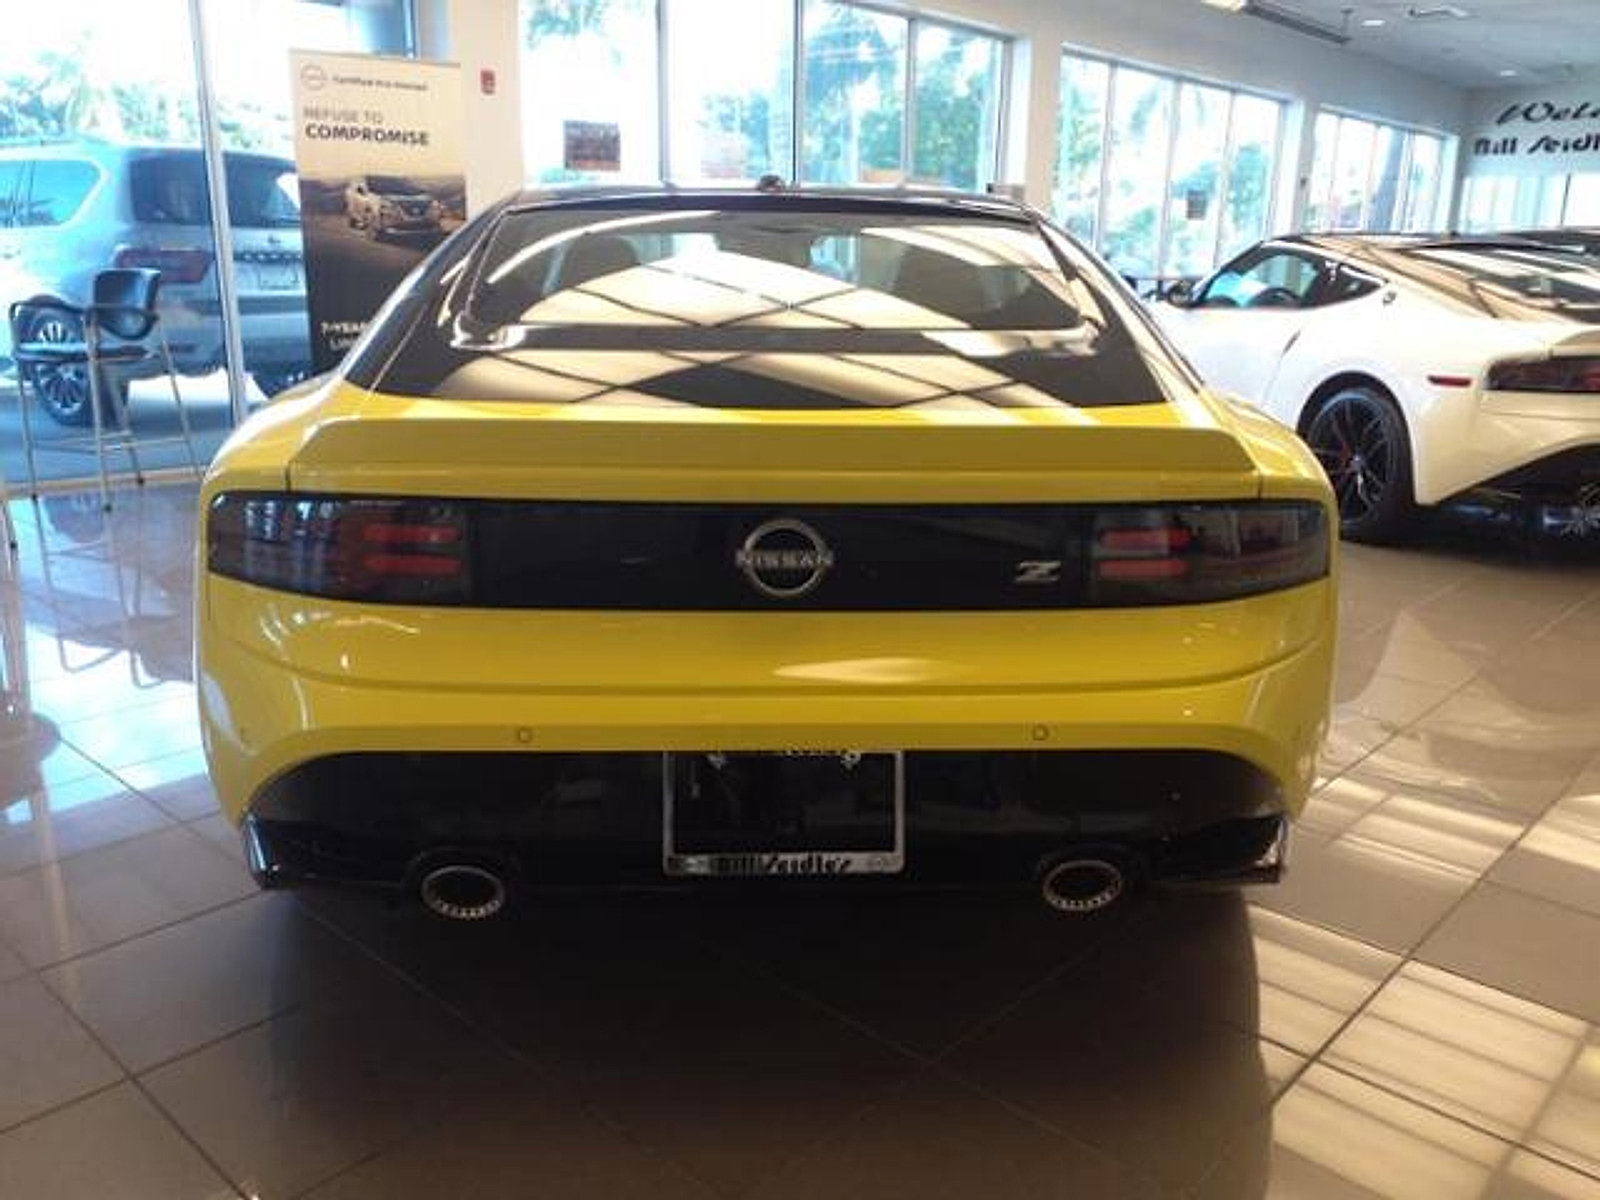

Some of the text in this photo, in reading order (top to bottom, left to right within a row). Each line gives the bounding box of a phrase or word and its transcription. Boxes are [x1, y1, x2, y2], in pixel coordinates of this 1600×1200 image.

[305, 122, 429, 146] COMPROMISE
[1474, 137, 1519, 155] Bill
[735, 549, 834, 569] NISSAN
[1014, 560, 1061, 584] Z
